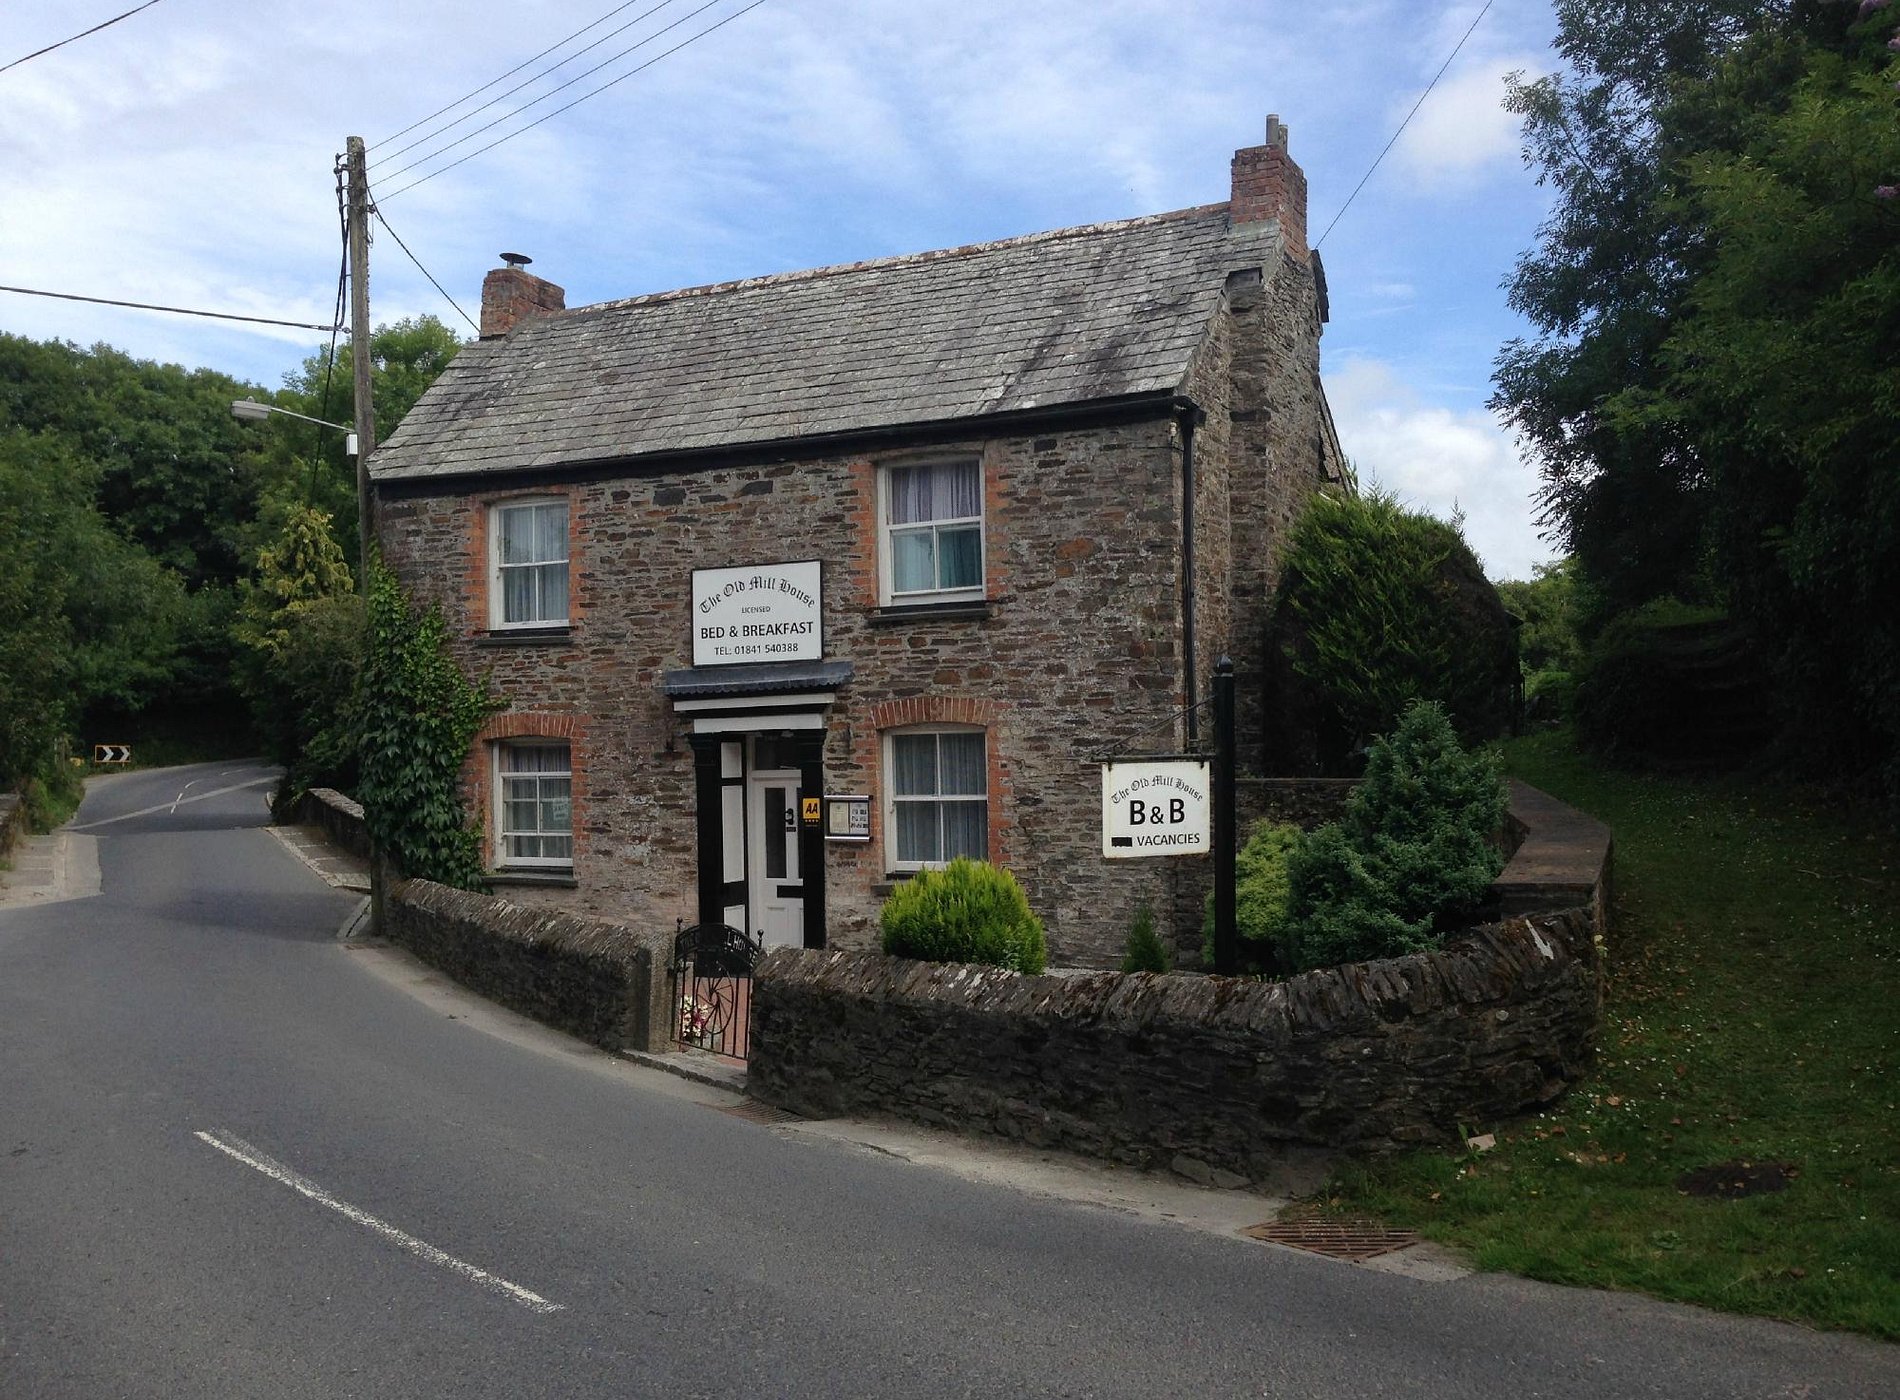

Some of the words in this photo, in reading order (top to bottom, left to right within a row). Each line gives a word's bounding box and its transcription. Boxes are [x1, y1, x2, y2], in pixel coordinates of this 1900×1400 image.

[699, 594, 721, 613] The
[723, 580, 746, 597] Old
[749, 576, 776, 591] Mill
[779, 578, 815, 608] House
[741, 606, 771, 614] LICENSED
[700, 626, 725, 639] BED
[729, 626, 738, 638] &
[742, 621, 814, 637] BREAKFAST
[714, 646, 732, 656] TEL:
[734, 645, 761, 655] 01841
[765, 643, 799, 654] 540388
[1111, 788, 1129, 804] The
[1130, 778, 1150, 791] Old
[1151, 775, 1174, 787] Mill
[1175, 778, 1203, 802] House
[805, 803, 818, 814] AA
[1137, 833, 1200, 847] VACANCIES
